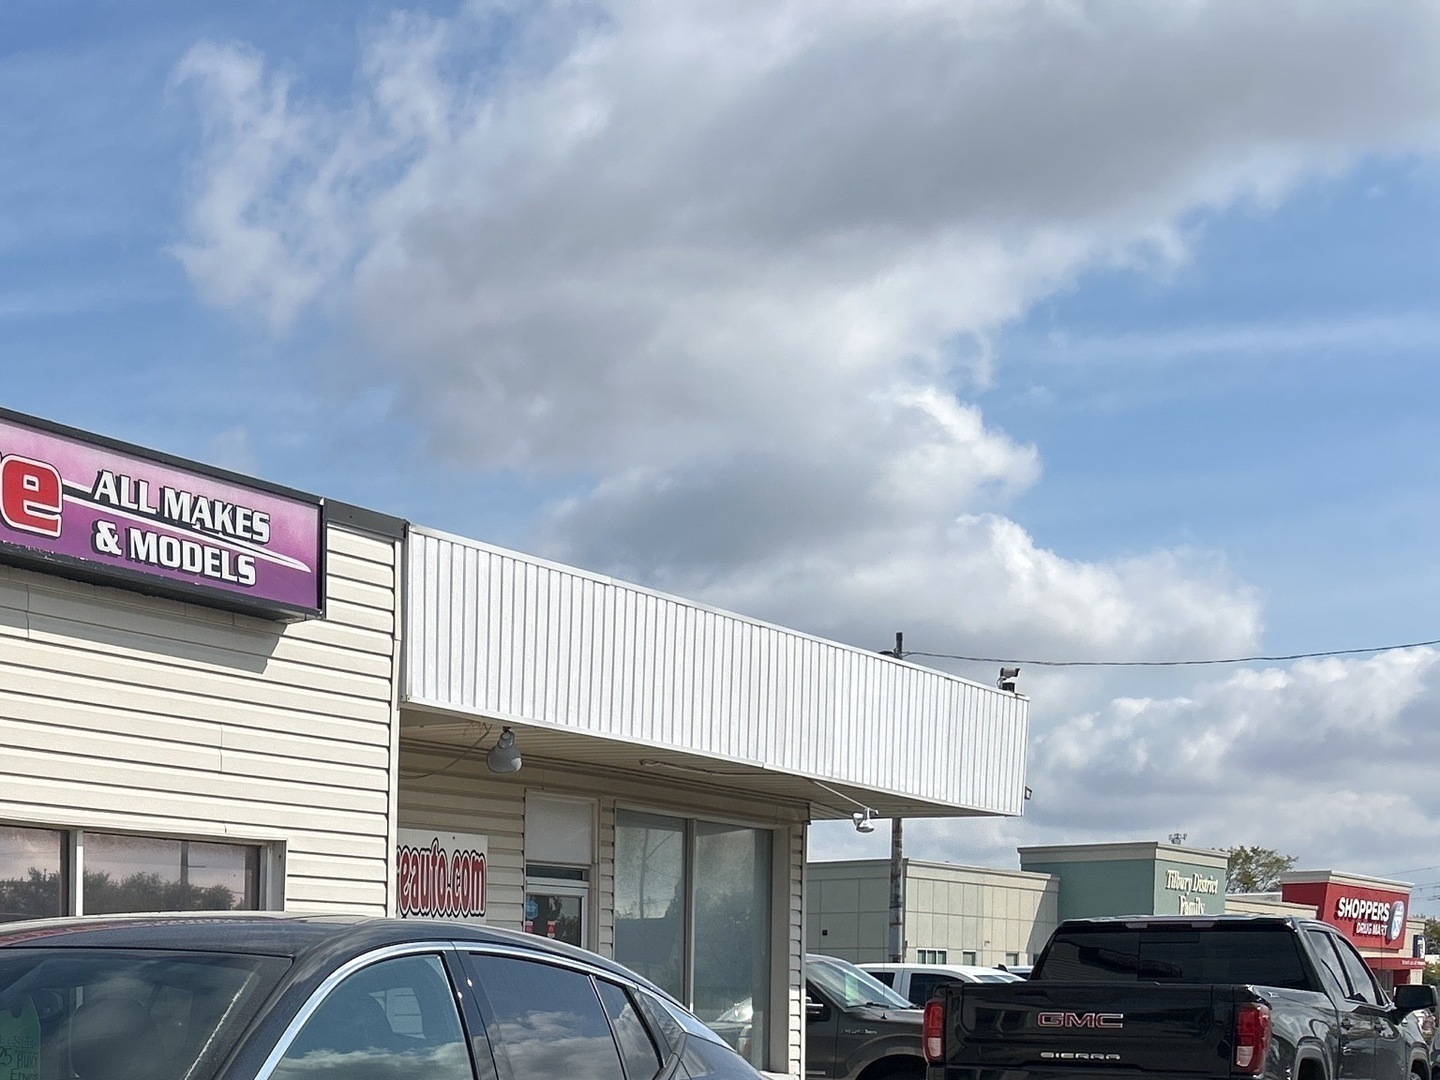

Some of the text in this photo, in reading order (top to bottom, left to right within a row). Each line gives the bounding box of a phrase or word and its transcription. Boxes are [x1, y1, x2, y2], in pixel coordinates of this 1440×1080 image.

[92, 470, 270, 545] ALL MAKES
[94, 520, 257, 588] & MODELS
[1166, 869, 1219, 895] Tilbury District
[1337, 897, 1391, 922] SHOPPERS
[1356, 922, 1389, 936] DRUG MART
[1038, 1012, 1124, 1029] GMC
[1040, 1052, 1120, 1060] SIERRA
